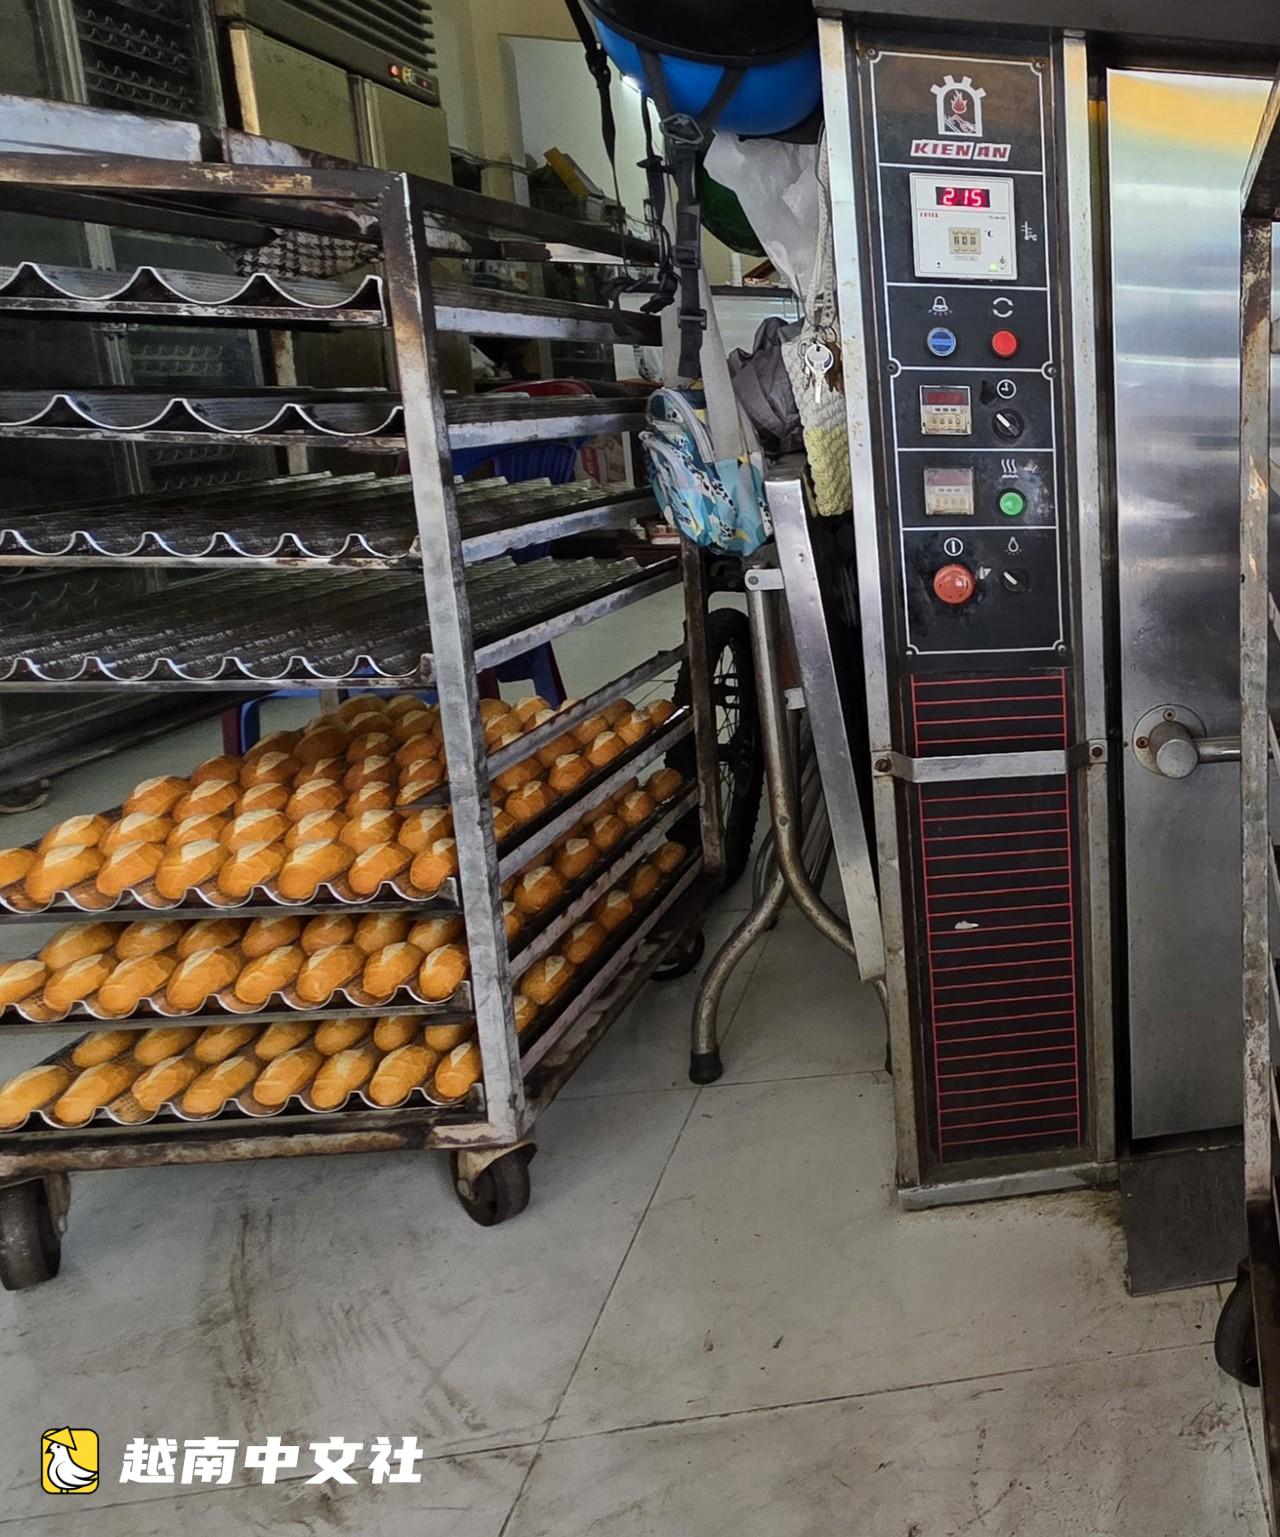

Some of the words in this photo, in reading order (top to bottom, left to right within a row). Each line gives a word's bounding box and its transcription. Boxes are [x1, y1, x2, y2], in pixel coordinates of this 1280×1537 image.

[912, 141, 972, 158] KIEN
[976, 144, 1008, 159] AN
[942, 187, 983, 207] 215
